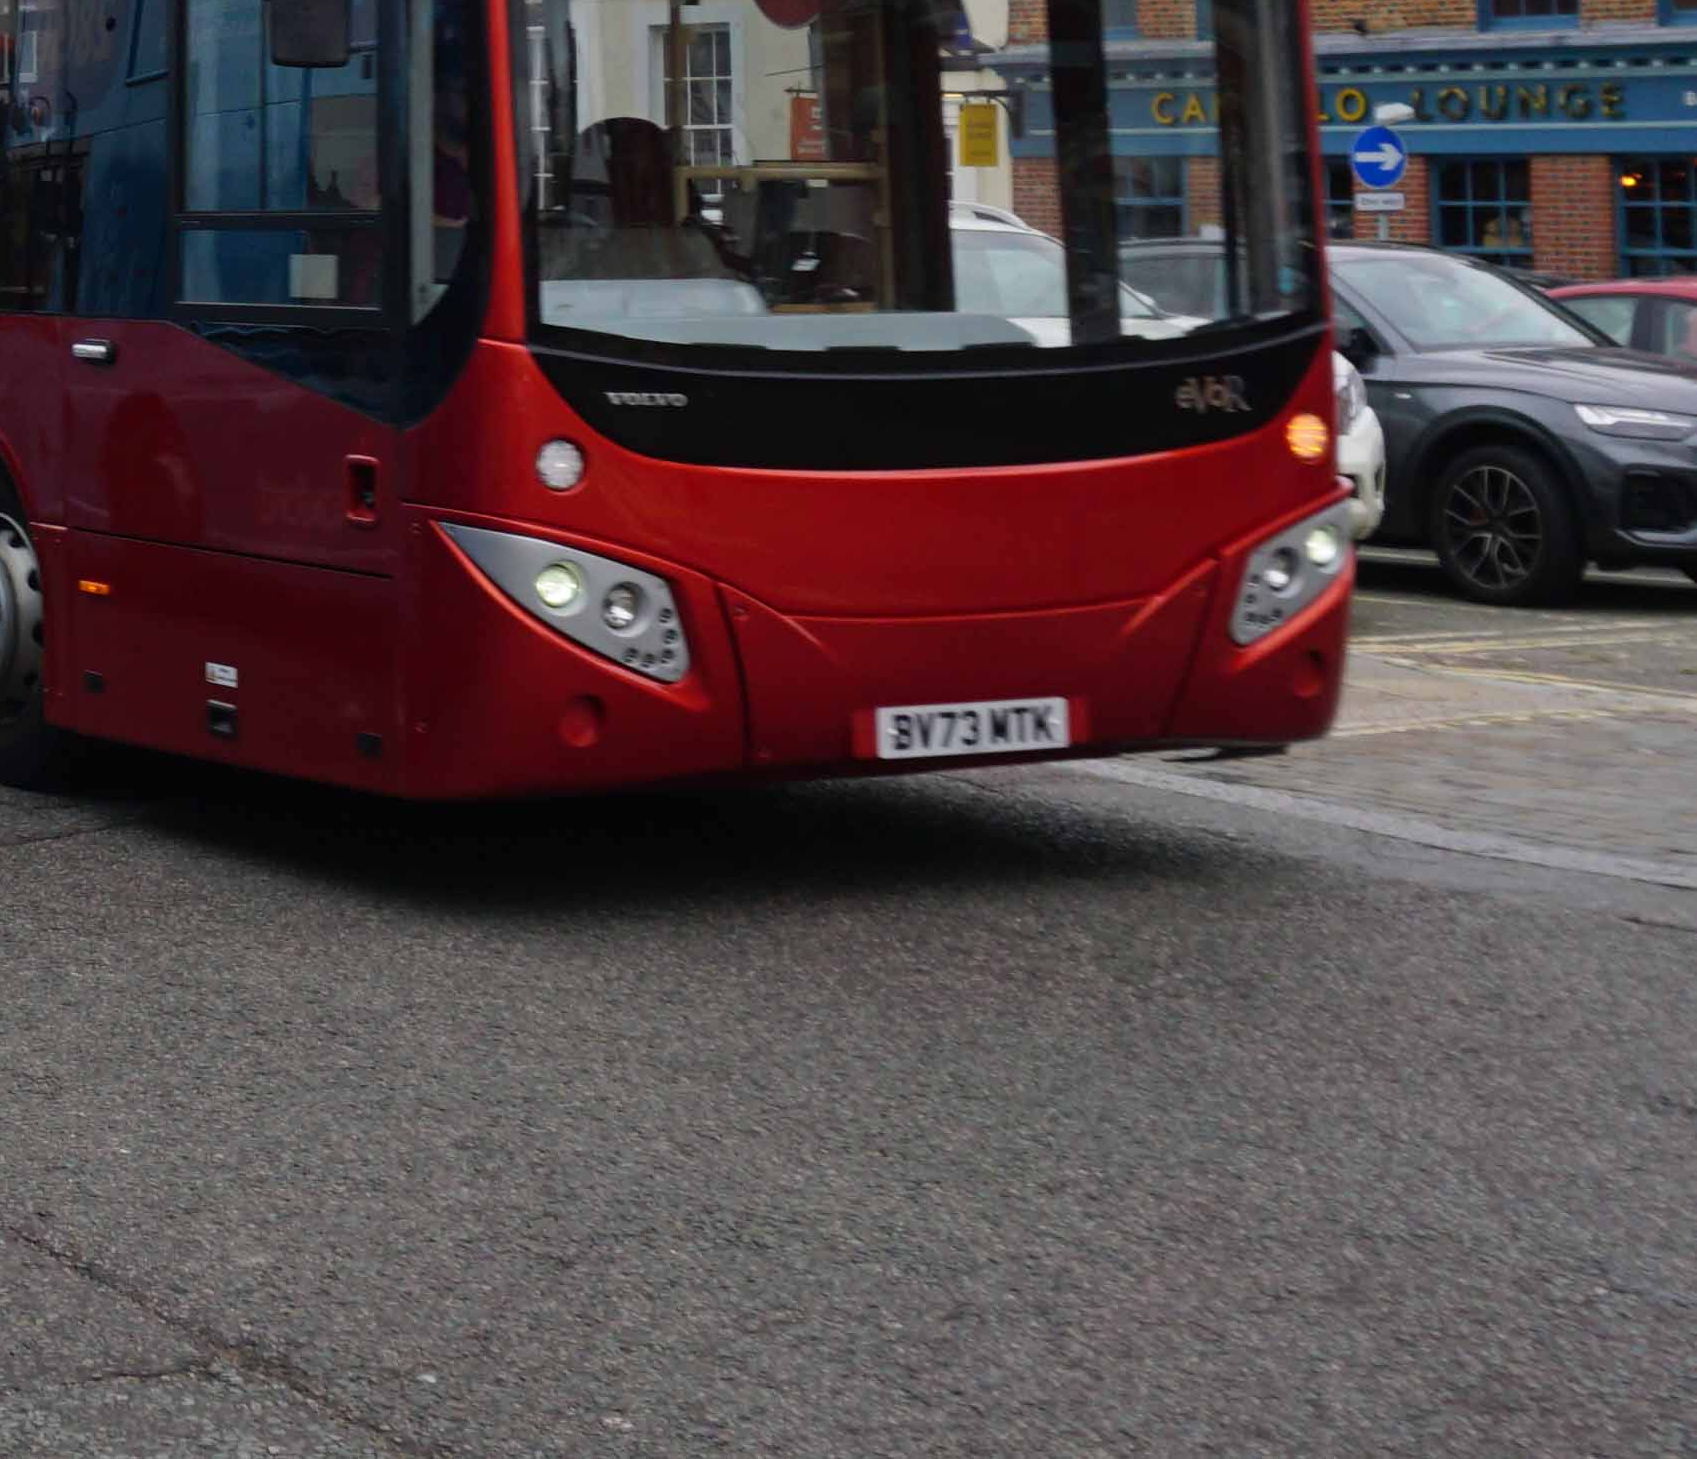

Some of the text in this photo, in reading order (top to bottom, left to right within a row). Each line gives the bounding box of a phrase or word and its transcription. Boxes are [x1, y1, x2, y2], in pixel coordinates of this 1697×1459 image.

[1409, 83, 1626, 123] LOUNGE
[602, 391, 689, 407] VOLVO
[892, 709, 980, 751] BV73
